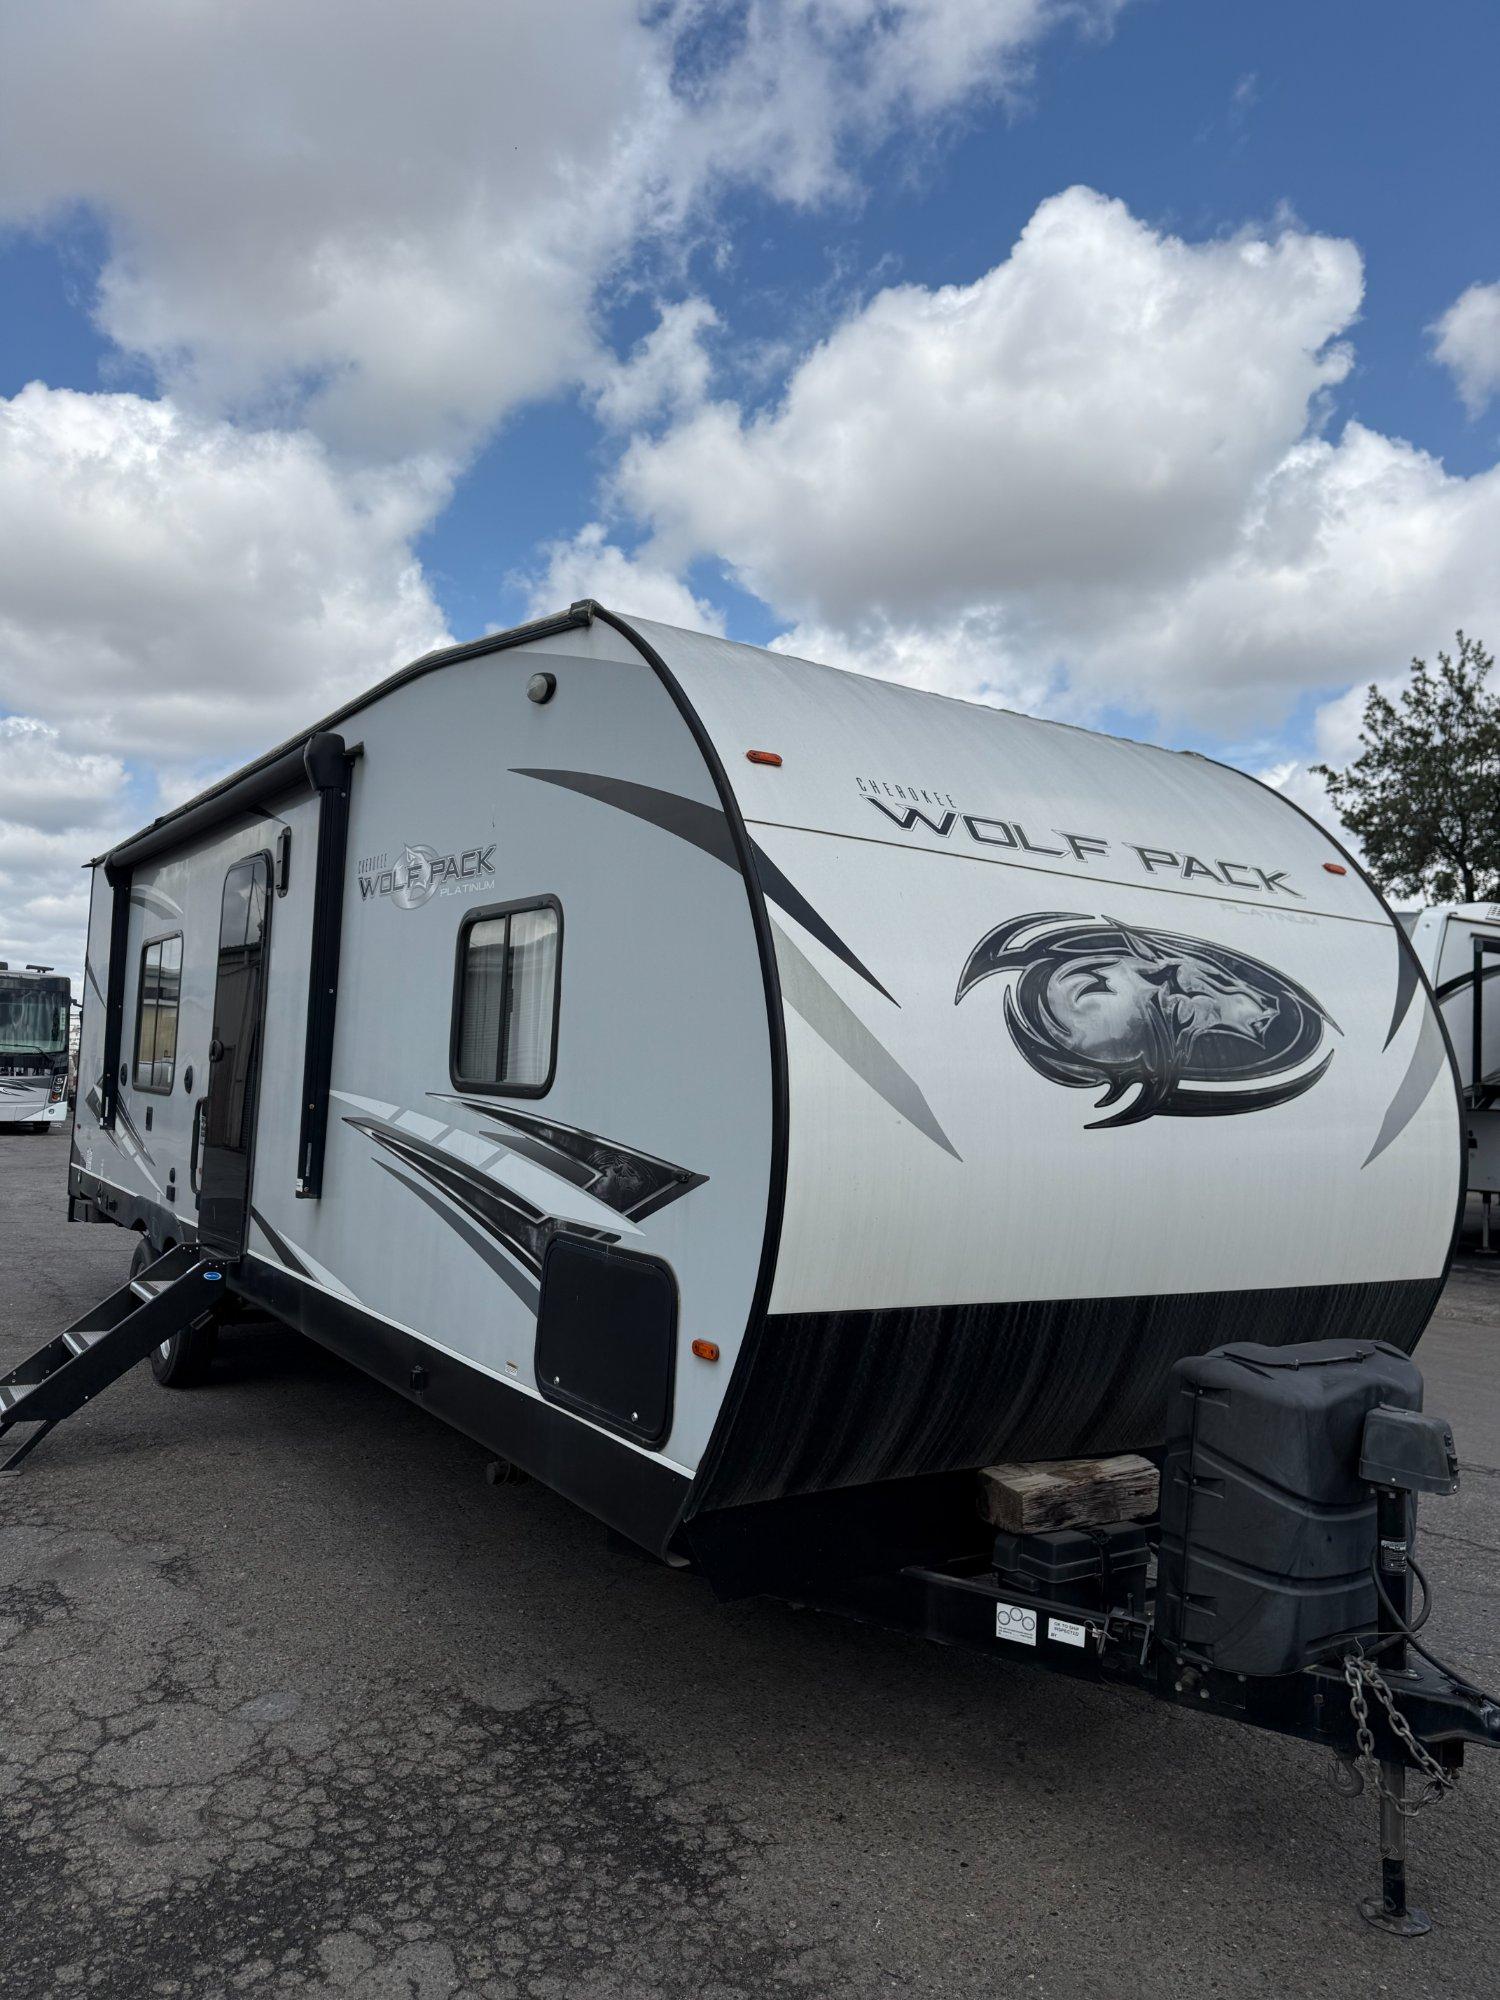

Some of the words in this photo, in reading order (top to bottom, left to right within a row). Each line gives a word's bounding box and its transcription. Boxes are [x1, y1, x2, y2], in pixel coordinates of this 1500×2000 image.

[856, 777, 957, 808] CHEROKEE
[859, 793, 1112, 863] WOLF
[1121, 841, 1307, 899] PACK
[358, 864, 423, 901] WOLF
[427, 845, 497, 884] PACK
[440, 879, 496, 897] PLATINUM
[1219, 903, 1320, 926] PLATINUM
